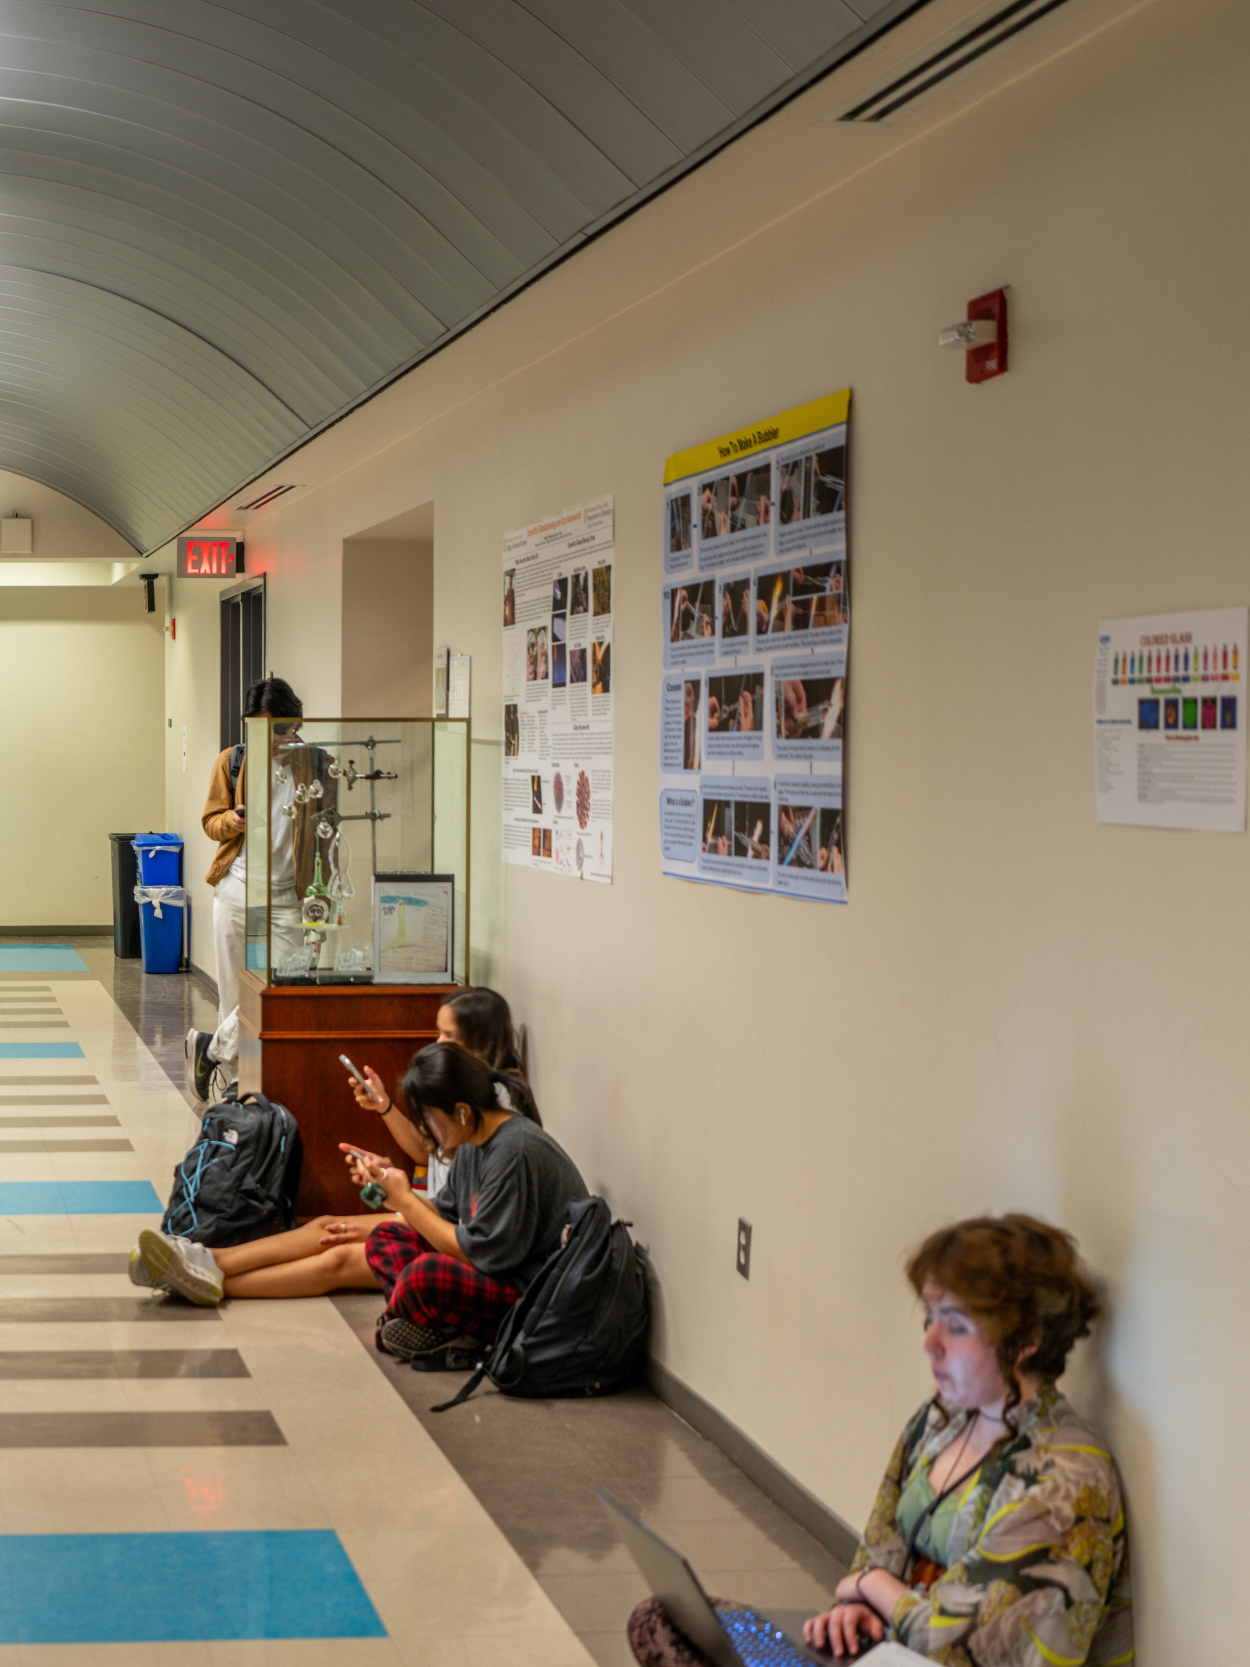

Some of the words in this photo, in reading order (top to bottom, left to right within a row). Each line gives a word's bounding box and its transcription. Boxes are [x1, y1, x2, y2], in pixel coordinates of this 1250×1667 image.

[718, 445, 730, 458] How
[738, 437, 753, 451] Make
[758, 427, 780, 445] Bubbler
[187, 541, 230, 575] EXIT
[1140, 634, 1169, 646] COLORED
[1170, 632, 1193, 644] GLASS
